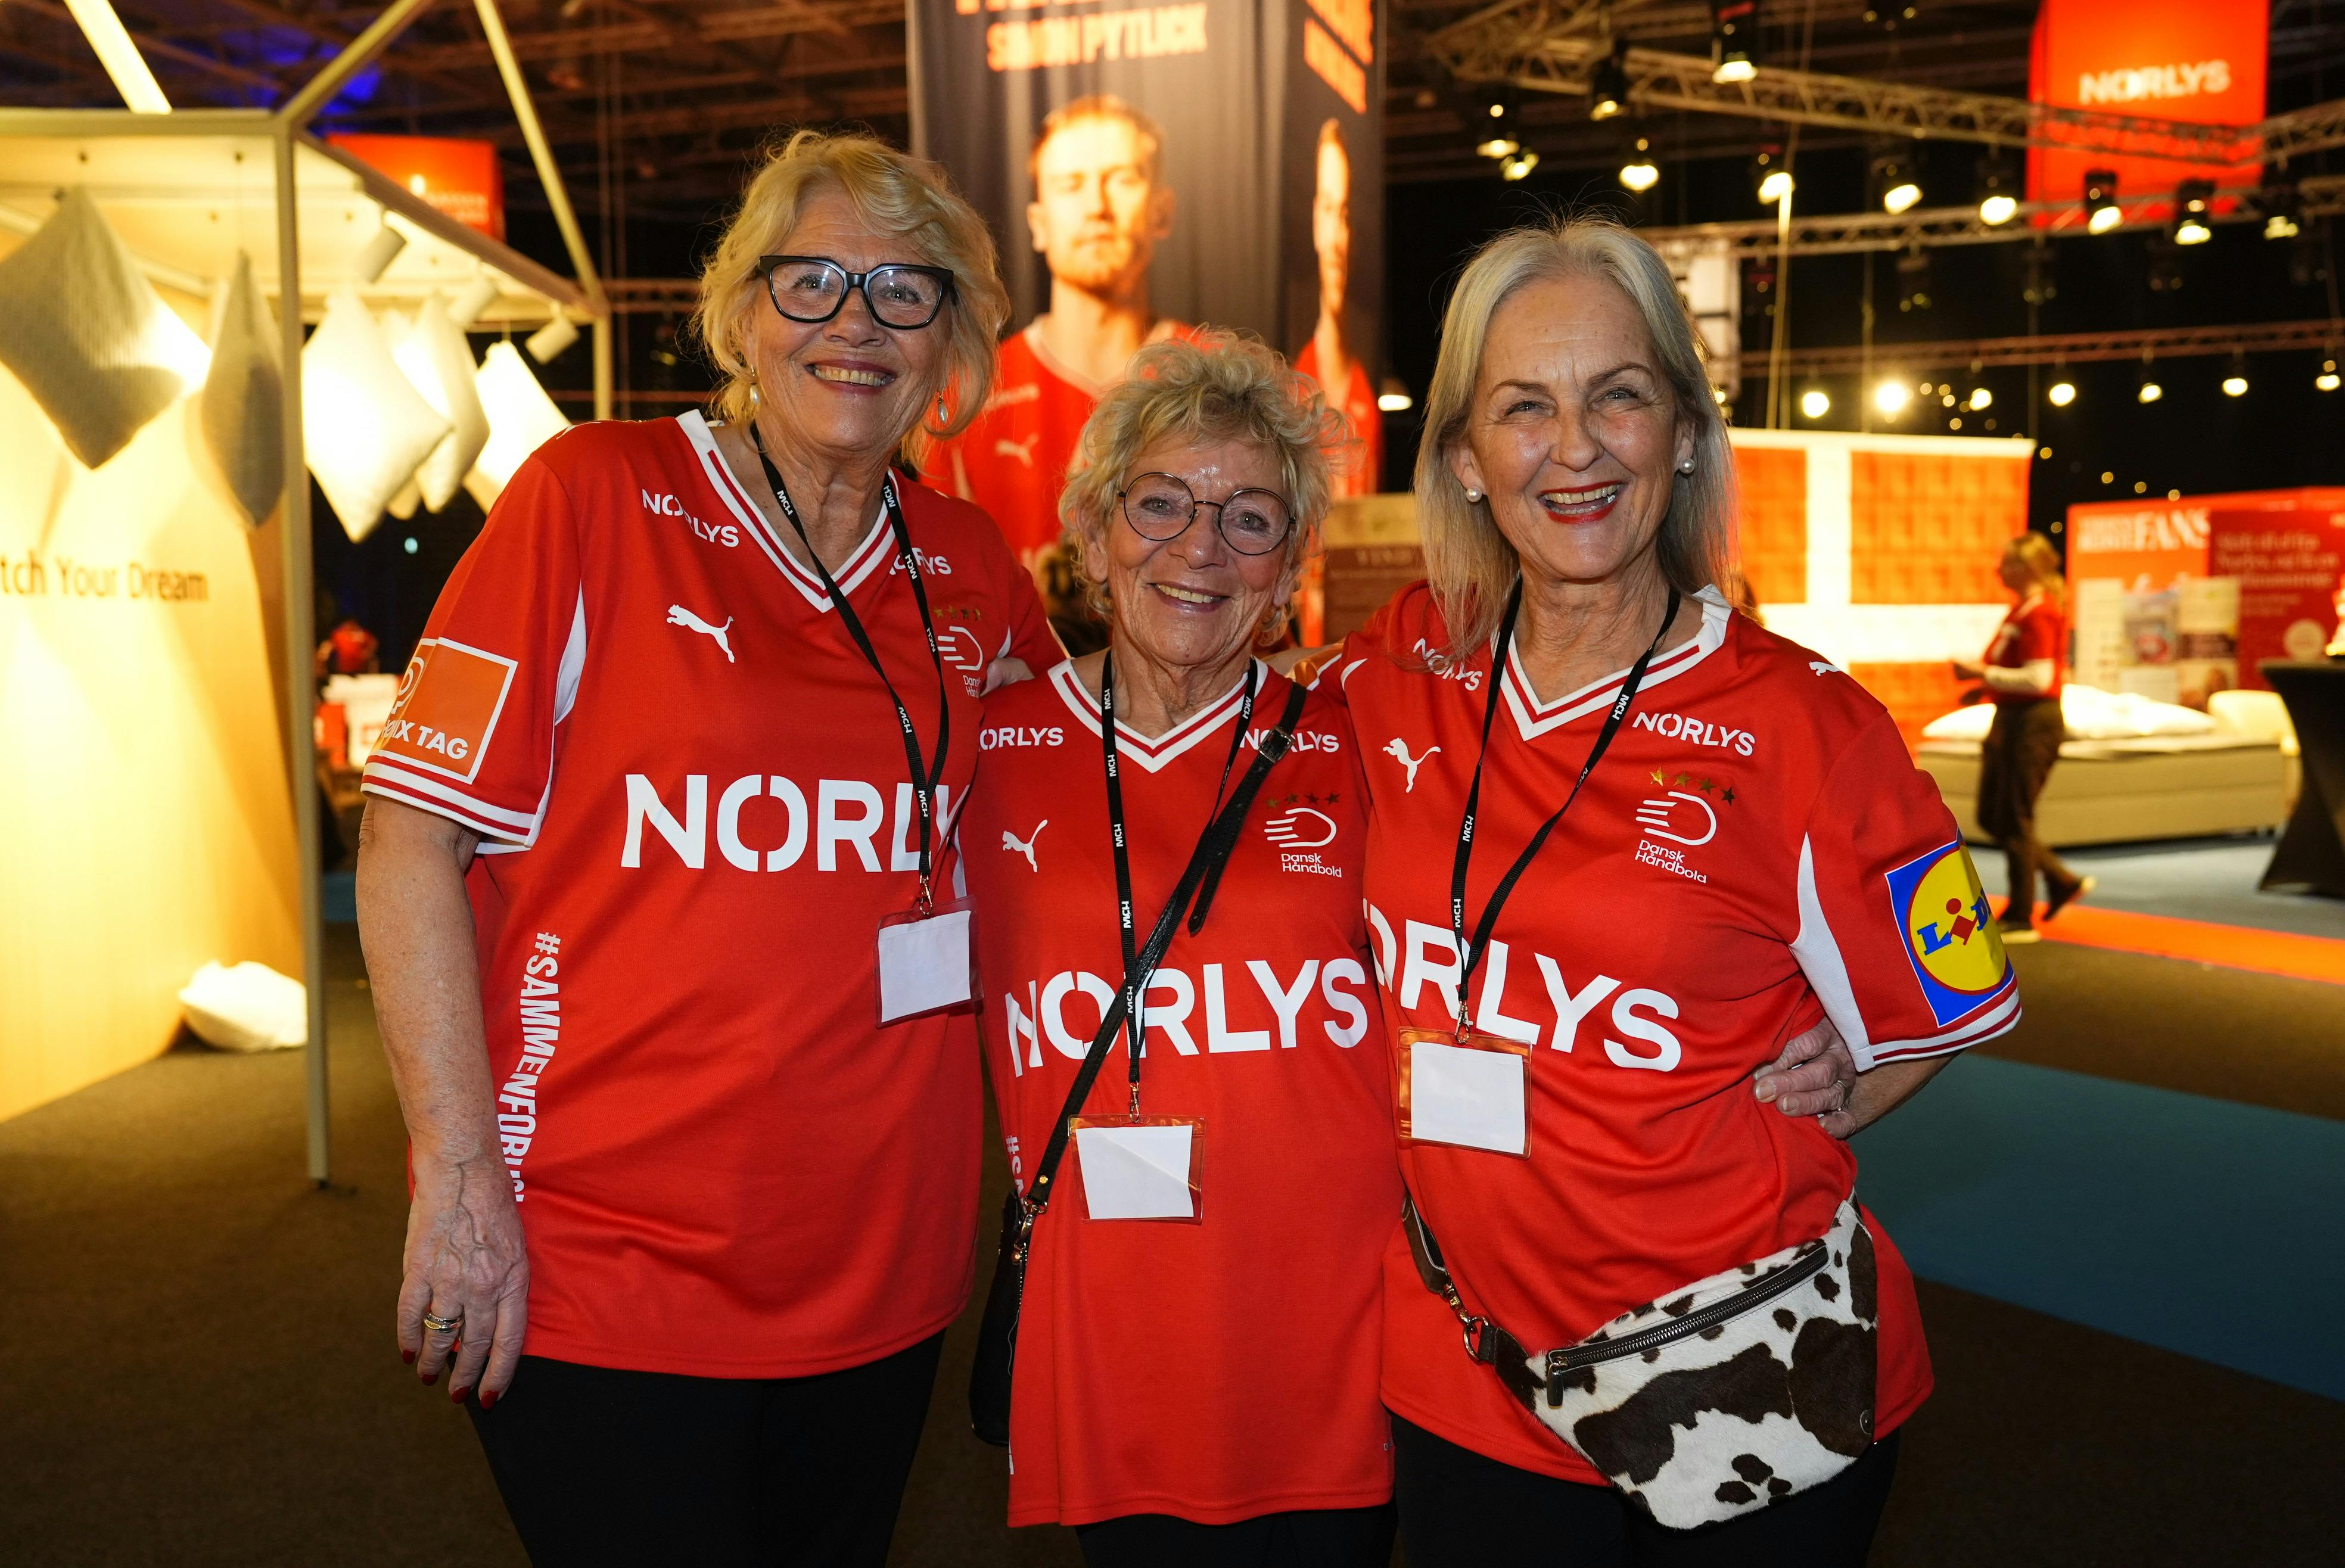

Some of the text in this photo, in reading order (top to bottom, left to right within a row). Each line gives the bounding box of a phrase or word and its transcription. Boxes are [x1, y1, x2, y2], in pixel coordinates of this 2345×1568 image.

[2078, 58, 2231, 105] NORLYS
[777, 490, 793, 515] MCH
[883, 485, 895, 508] MCH
[55, 557, 119, 596] Your
[127, 562, 209, 602] Dream
[904, 554, 918, 580] MCH
[926, 627, 936, 652] MCH
[898, 707, 912, 733] MCH
[1242, 696, 1251, 719] MCH
[1612, 694, 1629, 720] MCH
[416, 725, 468, 760] TAG
[978, 727, 1064, 751] ORLYS
[1632, 712, 1755, 757] NORLYS
[1108, 754, 1116, 777] MCH
[918, 790, 928, 817] MCH
[1114, 823, 1123, 847] MCH
[1462, 815, 1474, 842] MCH
[1281, 853, 1322, 863] Dansk
[1638, 839, 1685, 864] Dansk
[1282, 860, 1342, 878] Håndbold
[1634, 848, 1707, 883] Håndbold
[1121, 901, 1131, 928] MCH
[1363, 898, 1682, 1072] ORLYS
[1005, 958, 1369, 1077] NORLYS
